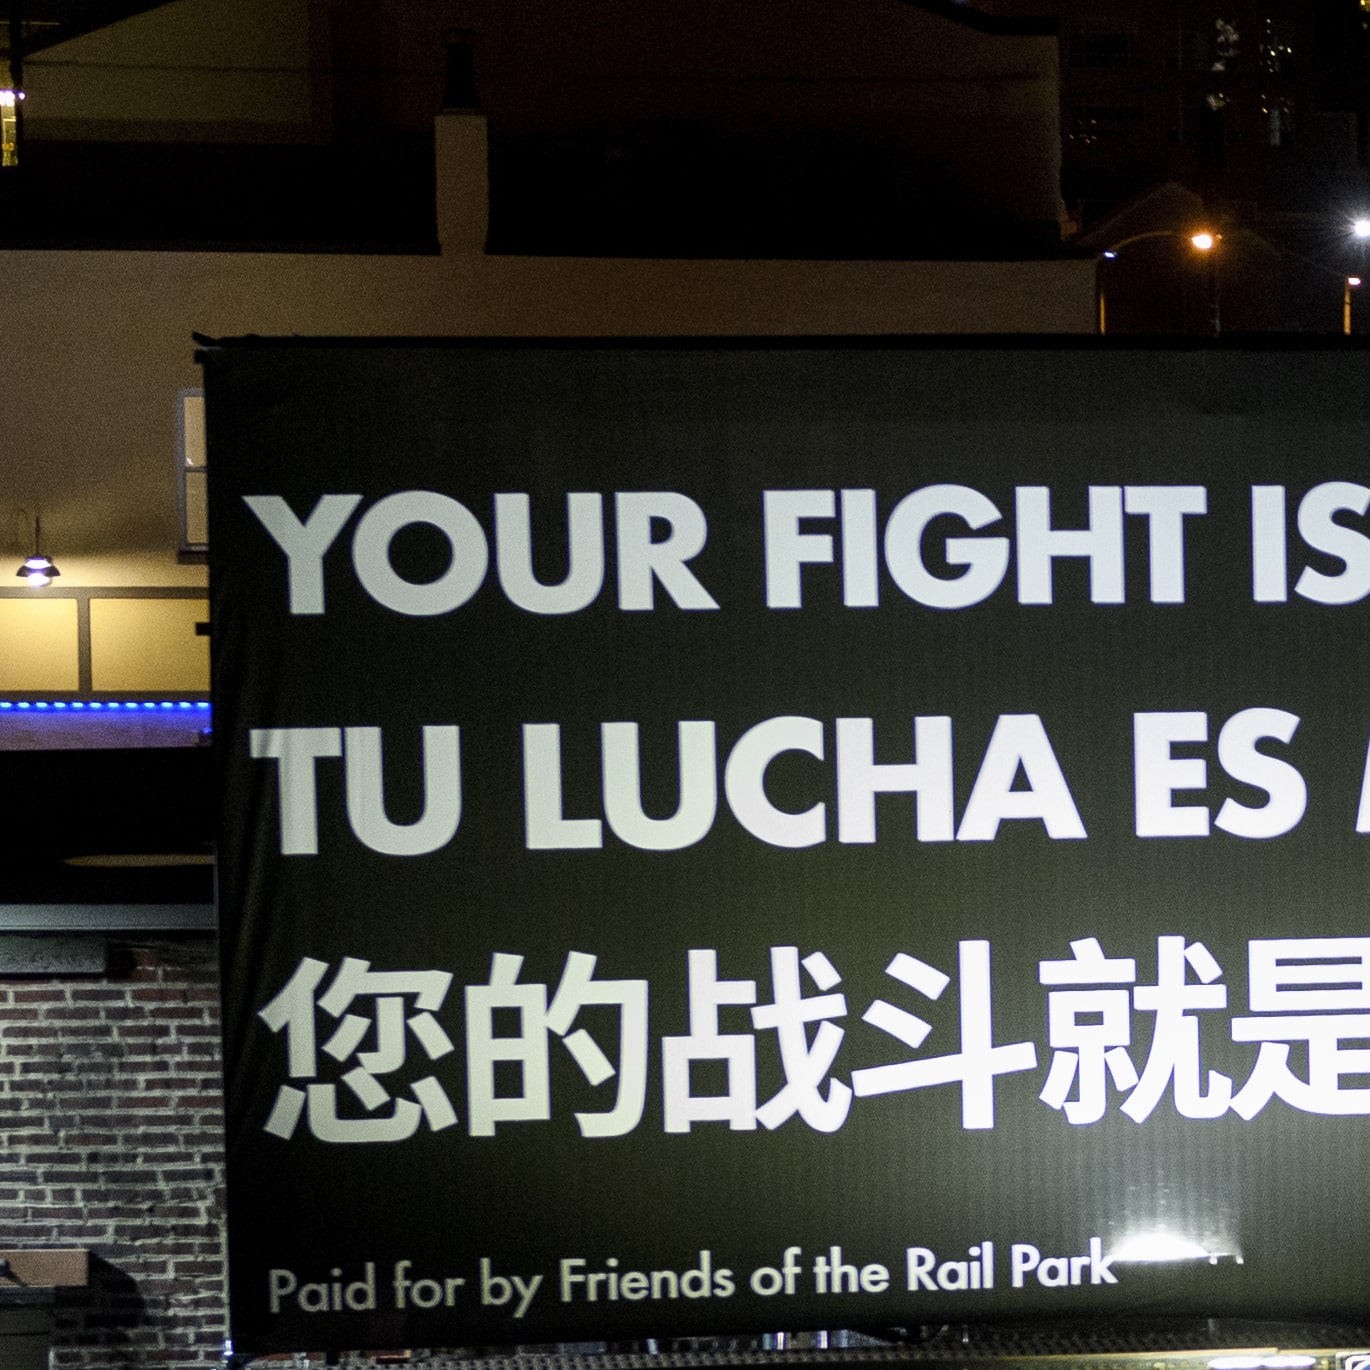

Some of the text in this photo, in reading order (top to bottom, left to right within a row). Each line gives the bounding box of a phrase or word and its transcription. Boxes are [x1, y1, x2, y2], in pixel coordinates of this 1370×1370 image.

[244, 491, 720, 616] YOUR
[762, 484, 1208, 610] FIGHT
[250, 726, 462, 856] TU
[522, 713, 1089, 852] LUCHA
[1132, 707, 1308, 840] ES
[268, 1238, 1118, 1319] Paid for by Friends of the Rail Park
